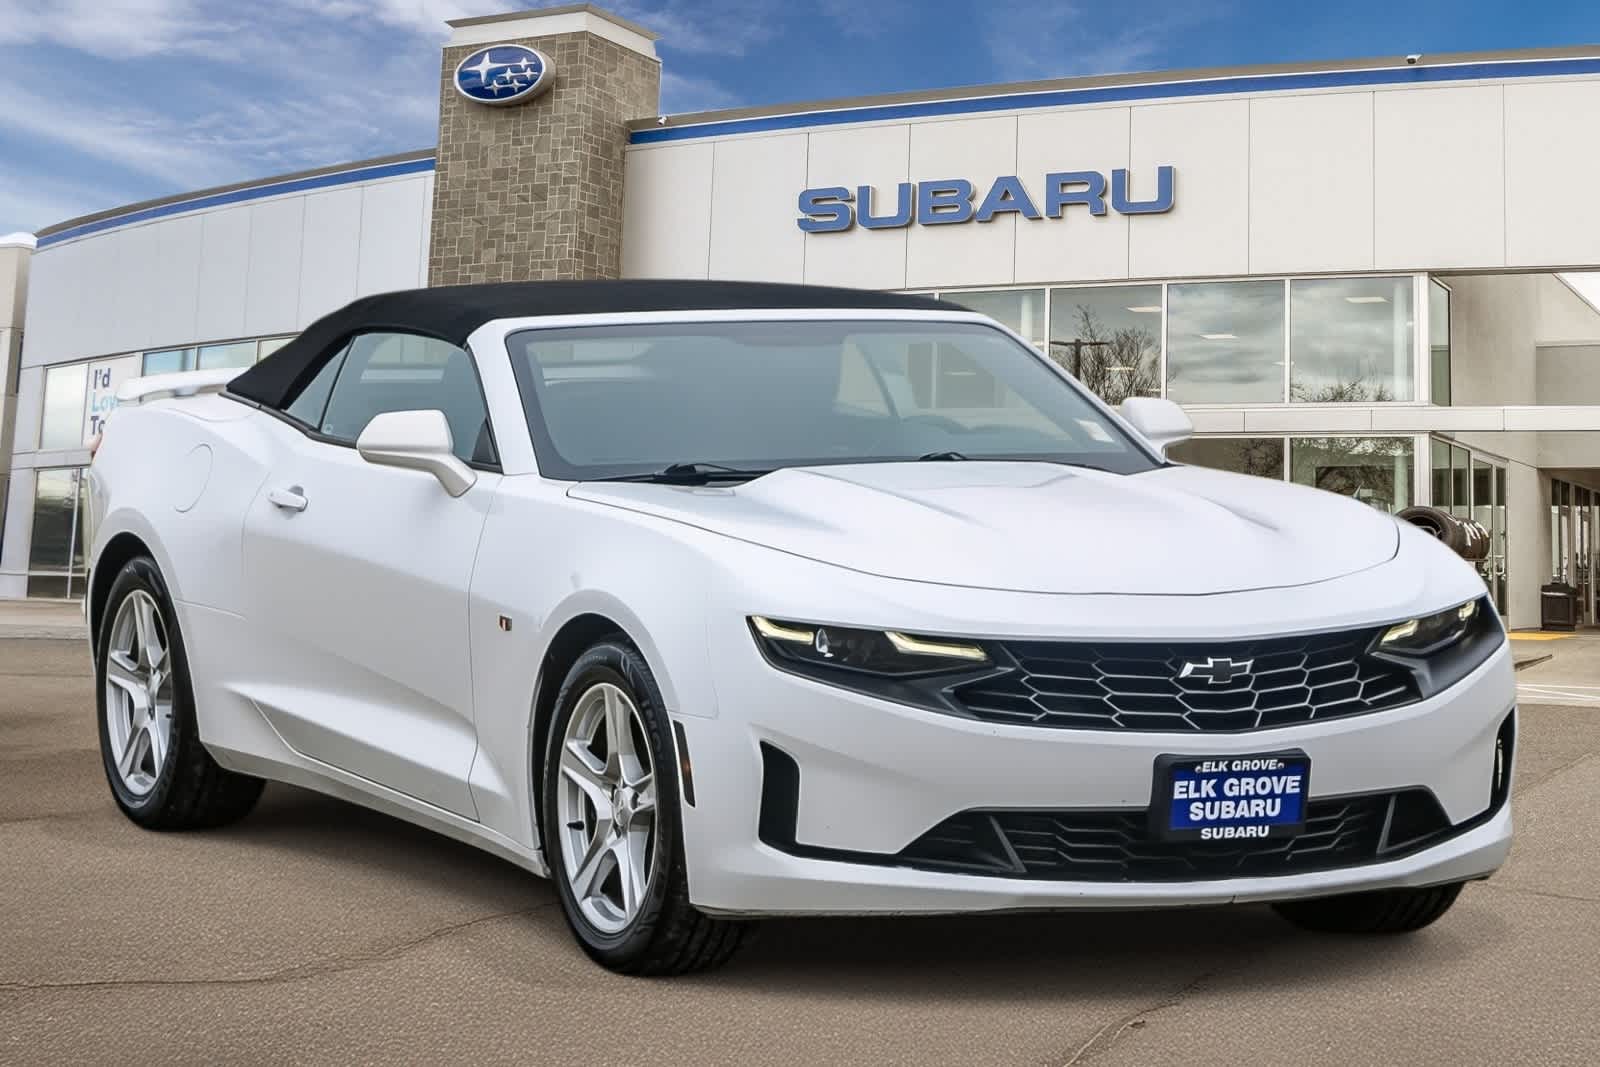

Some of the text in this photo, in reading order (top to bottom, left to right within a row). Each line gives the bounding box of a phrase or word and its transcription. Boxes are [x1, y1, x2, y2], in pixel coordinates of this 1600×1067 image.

[797, 165, 1176, 233] SUBARU
[94, 367, 111, 389] I'd
[1202, 759, 1278, 773] ELK GROVE
[1173, 775, 1301, 799] ELK GROVE
[1189, 798, 1282, 821] SUBARU
[1201, 825, 1270, 840] SUBARU
